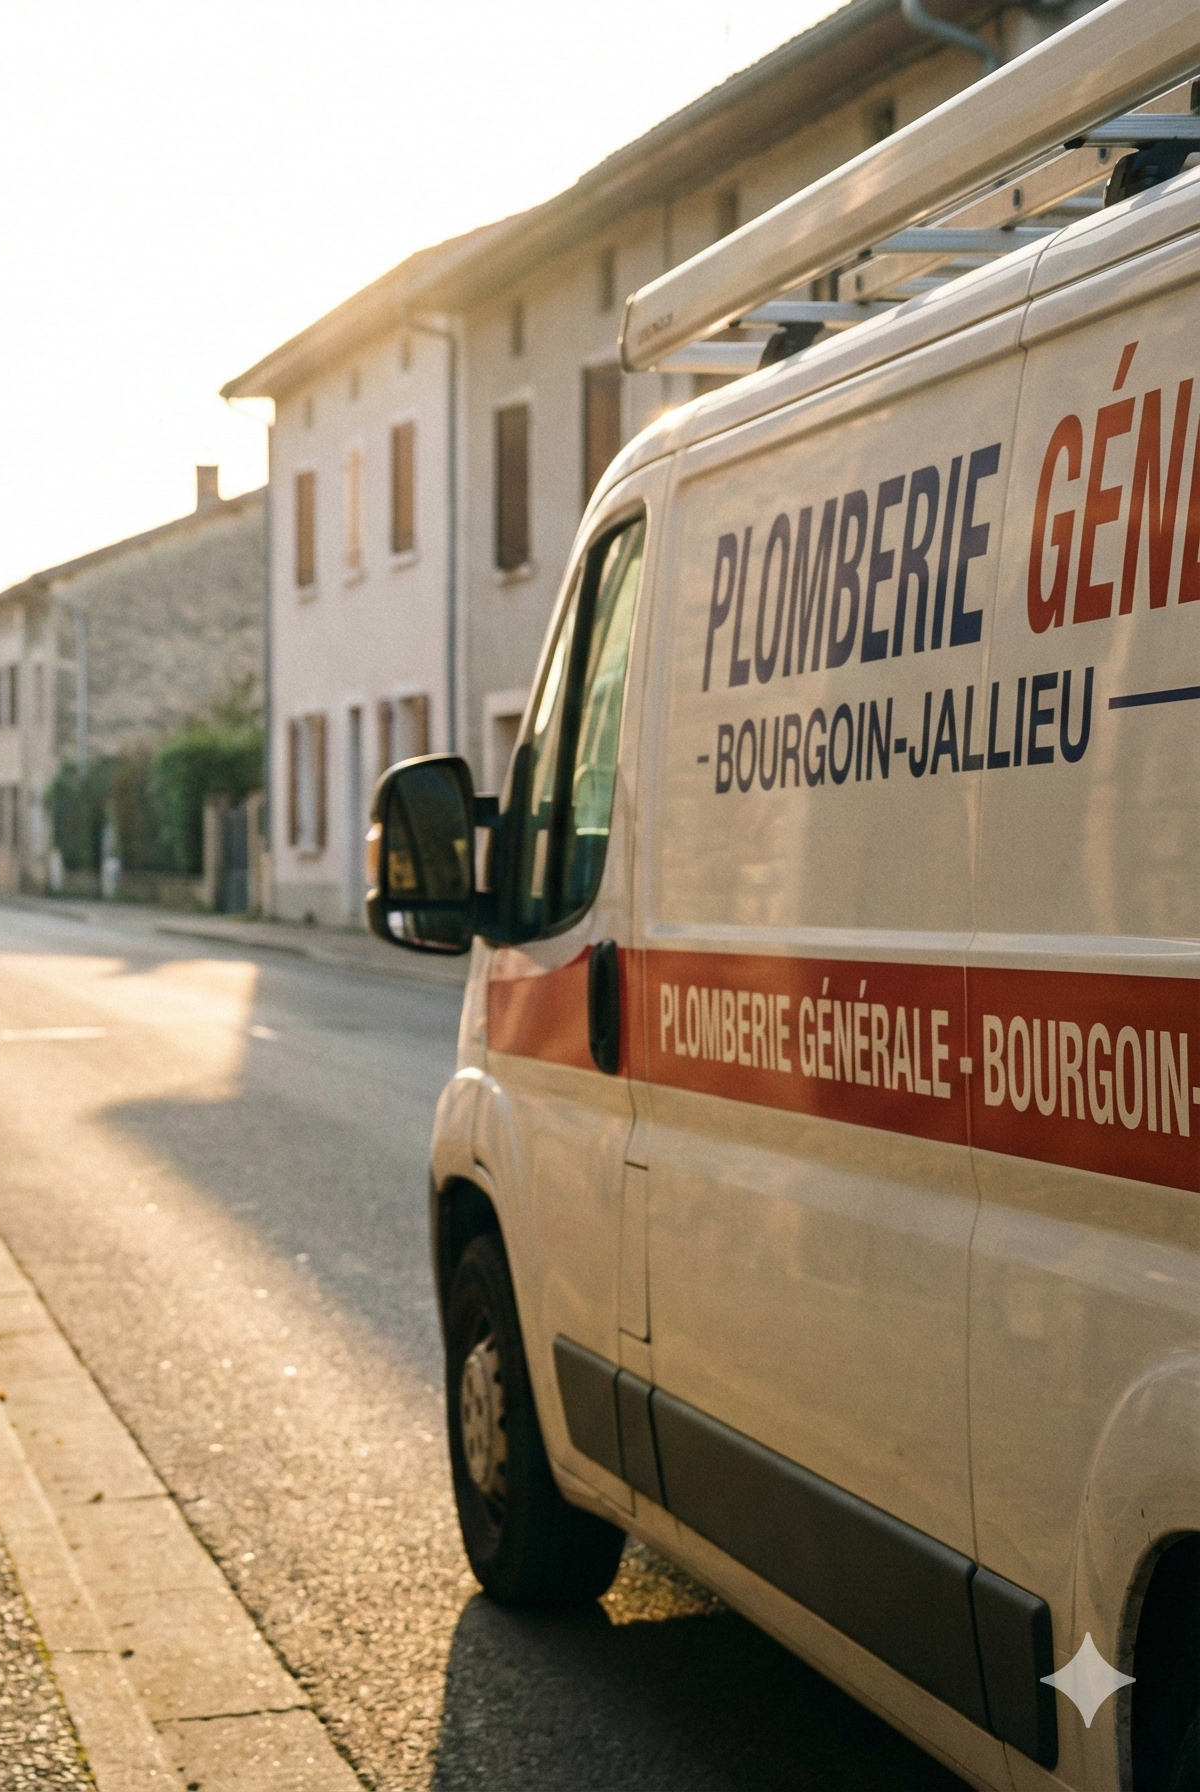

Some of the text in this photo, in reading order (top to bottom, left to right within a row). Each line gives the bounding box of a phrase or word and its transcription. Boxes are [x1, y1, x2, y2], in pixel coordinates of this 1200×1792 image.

[702, 443, 1002, 692] PLOMBERIE
[660, 983, 792, 1073] PLOMBERIE
[799, 976, 951, 1099] GÉNÉRALE
